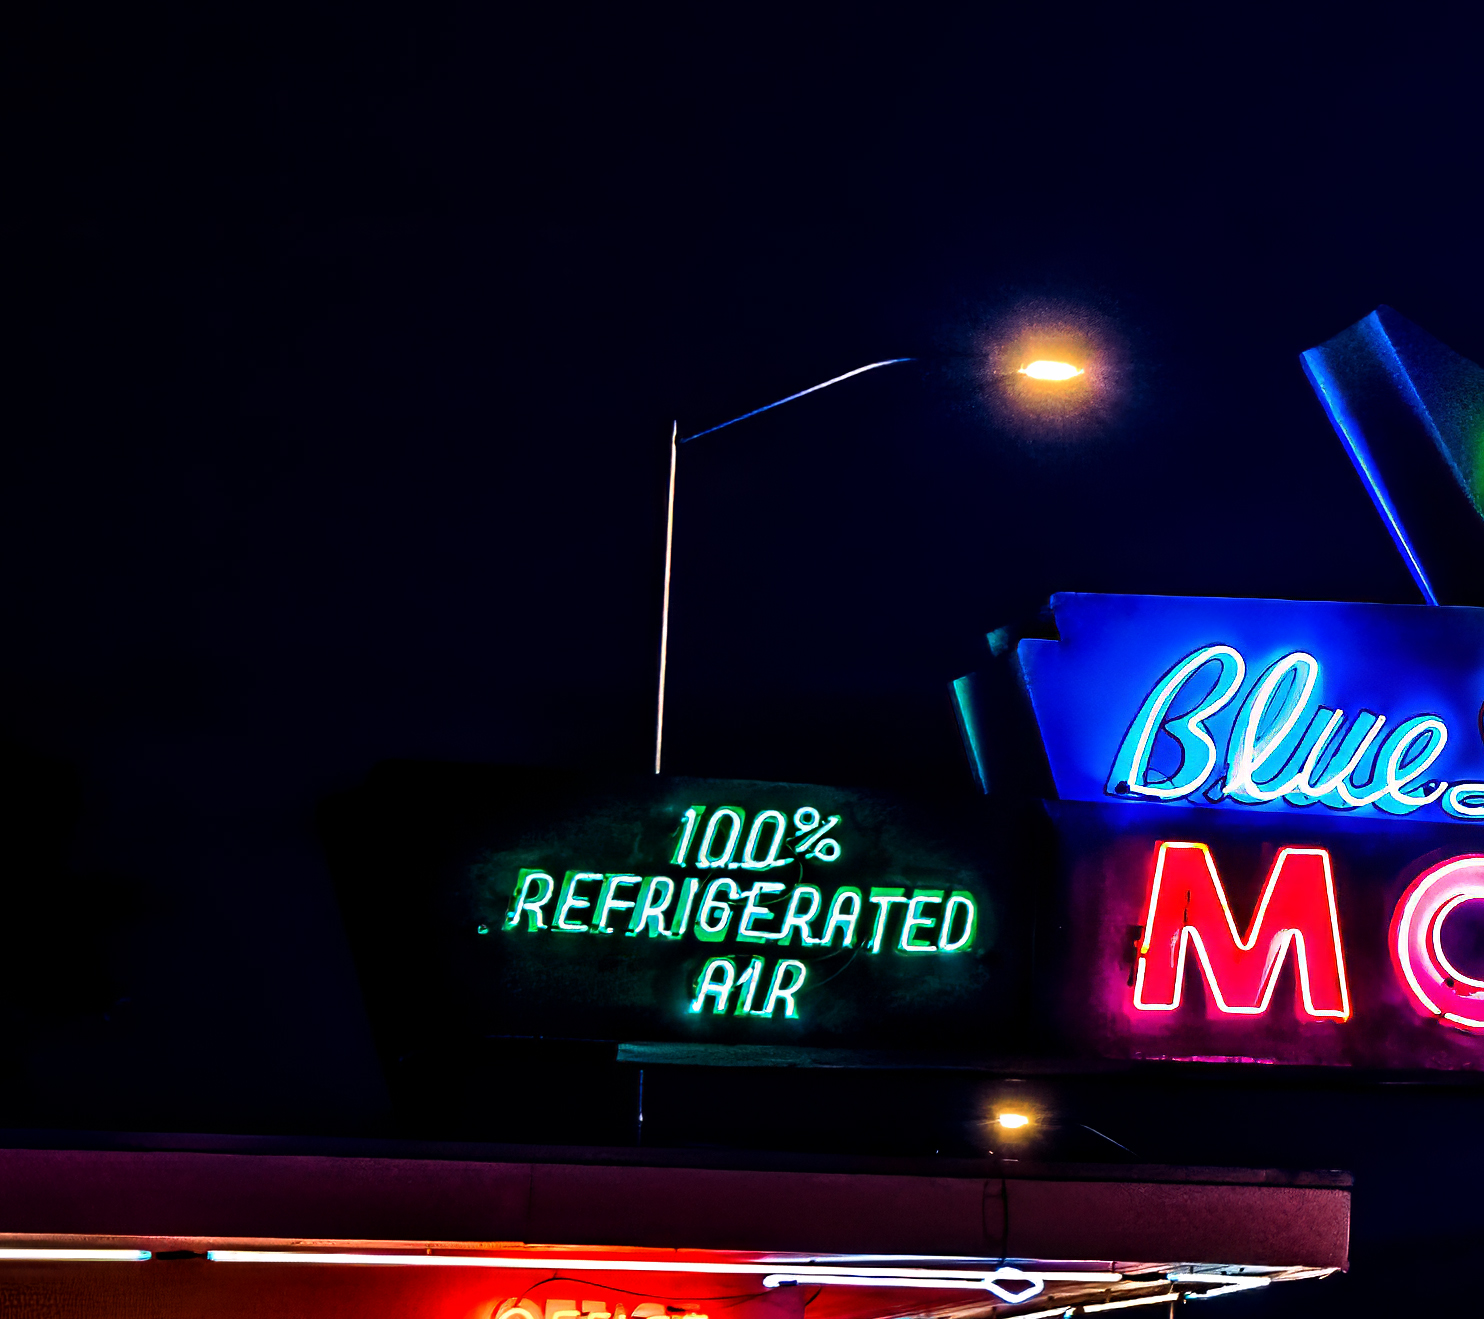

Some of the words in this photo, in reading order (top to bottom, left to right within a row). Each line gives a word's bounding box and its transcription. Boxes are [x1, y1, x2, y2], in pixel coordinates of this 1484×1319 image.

[1107, 643, 1448, 810] Blue
[674, 805, 842, 869] 100%
[503, 869, 979, 955] REFRIGERATED
[689, 955, 807, 1018] AIR
